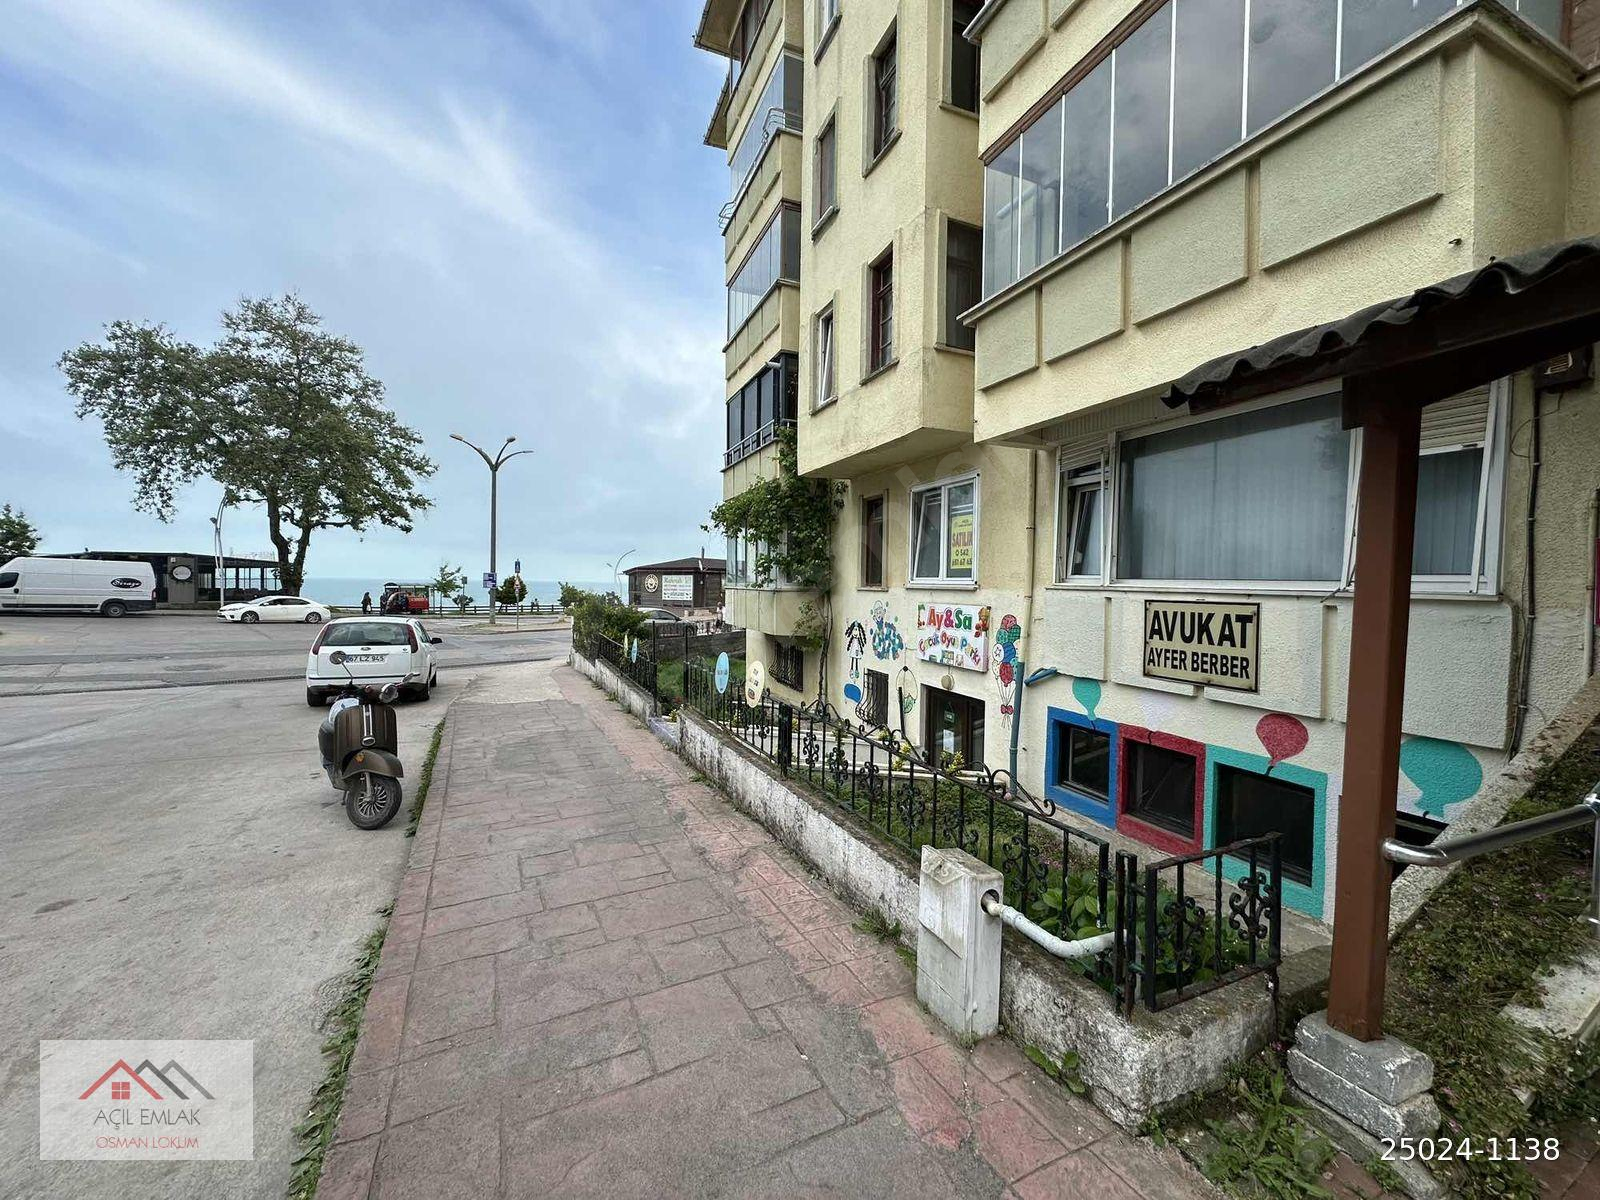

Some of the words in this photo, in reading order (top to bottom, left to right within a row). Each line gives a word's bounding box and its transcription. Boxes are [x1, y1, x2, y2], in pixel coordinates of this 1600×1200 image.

[927, 606, 973, 631] Ay&Sa
[1148, 610, 1254, 649] AVUKAT
[1147, 647, 1188, 672] AYFER
[1191, 652, 1250, 679] BERBER
